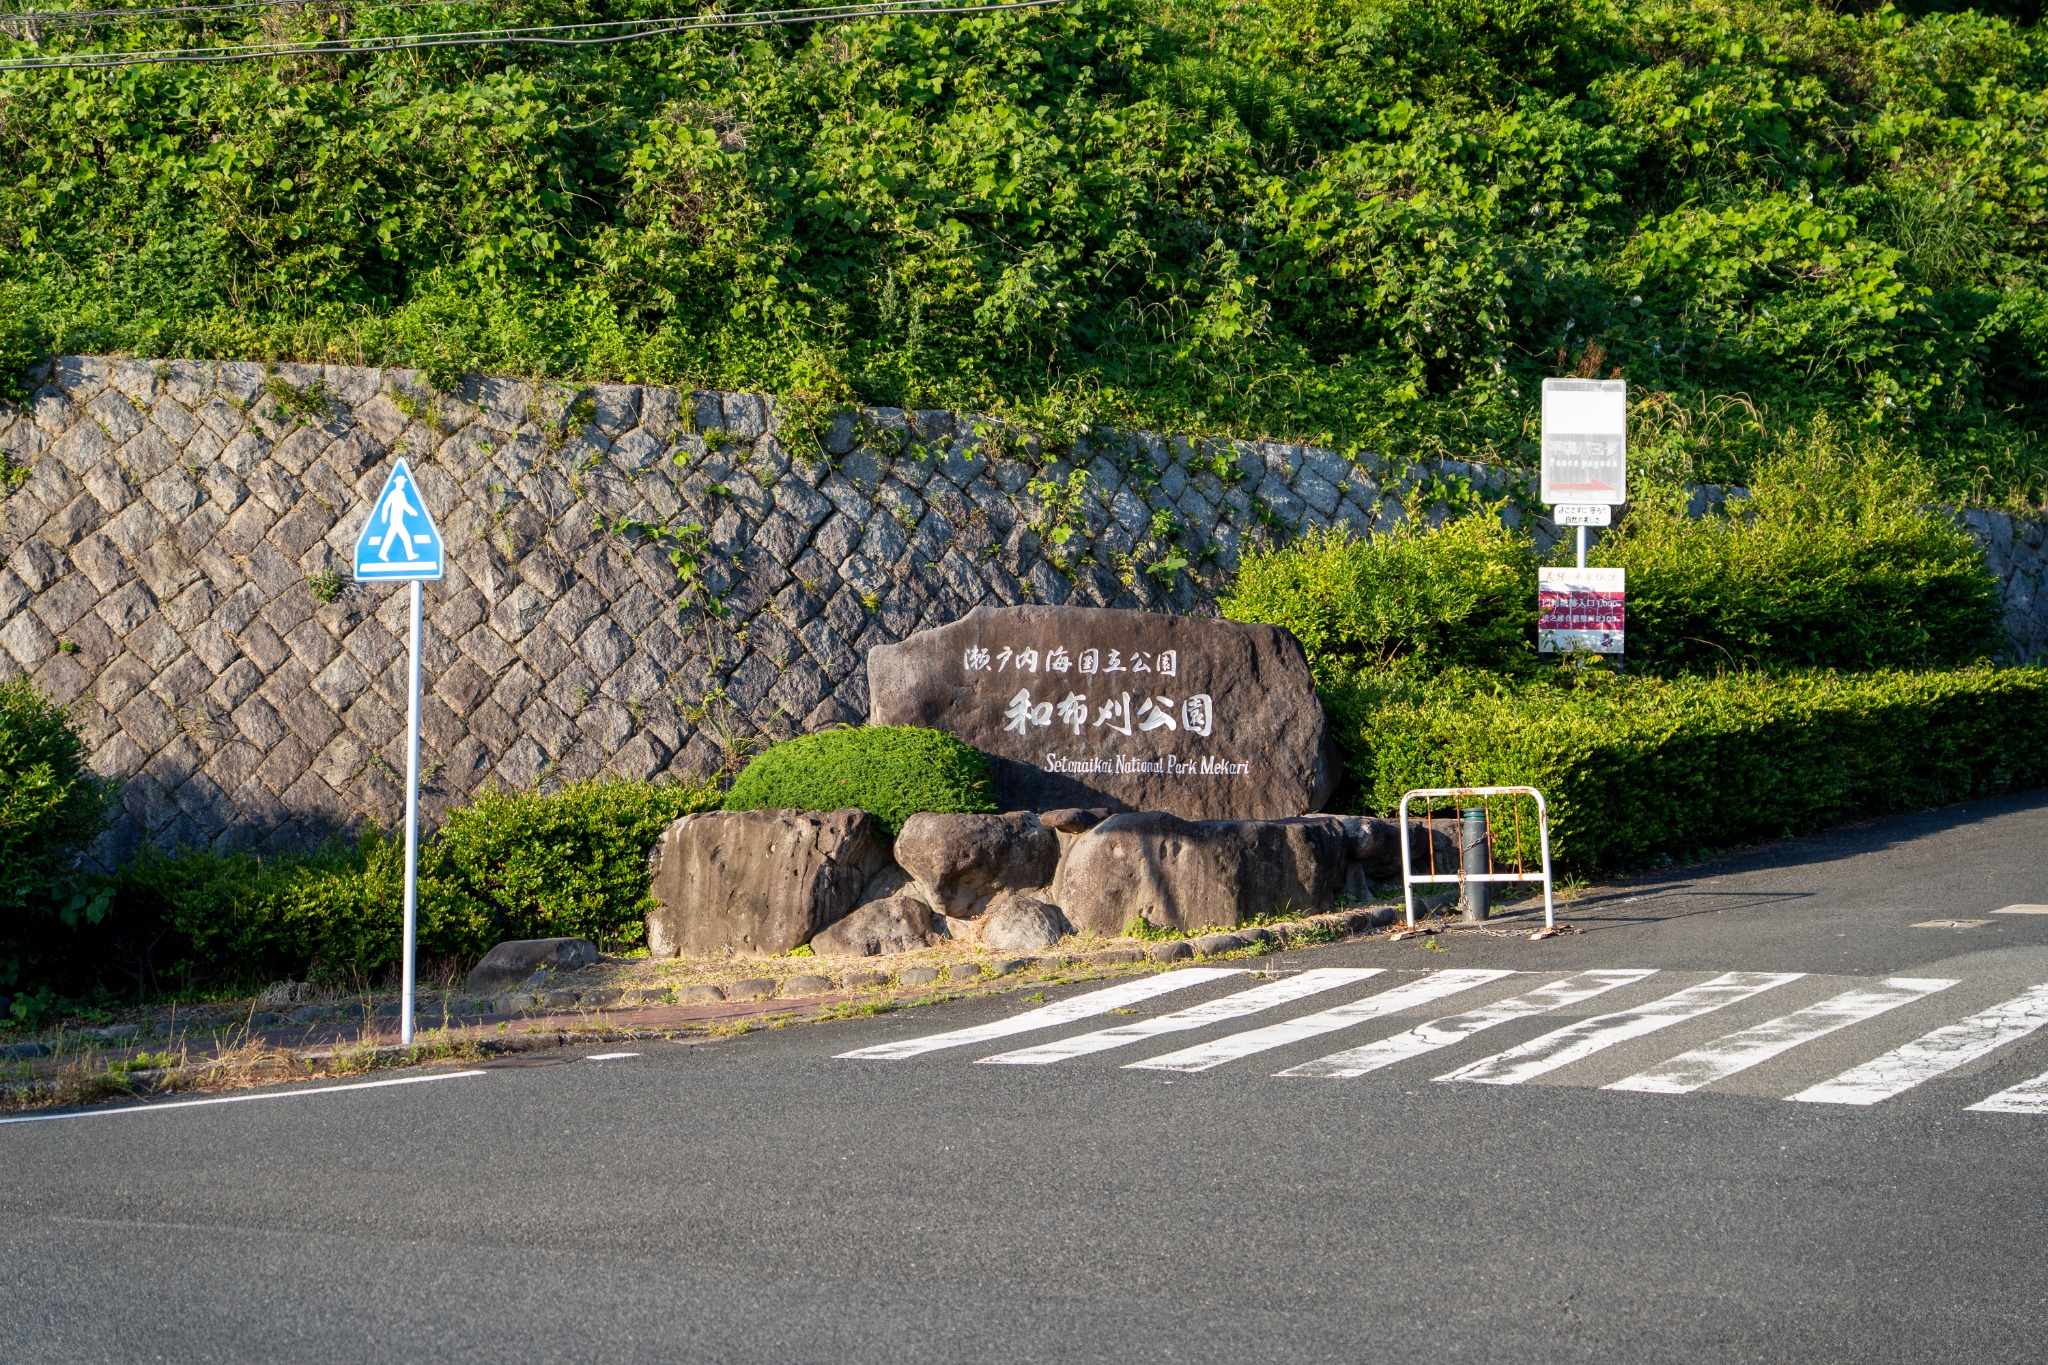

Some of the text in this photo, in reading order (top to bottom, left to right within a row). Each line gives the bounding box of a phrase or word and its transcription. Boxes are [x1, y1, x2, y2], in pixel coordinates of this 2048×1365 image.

[1549, 457, 1579, 467] Peace
[963, 645, 1178, 677] 瀬戸内海国立公園
[1003, 687, 1213, 737] 和布刈公園
[1043, 752, 1250, 775] Setonaikai National Park Mekari
